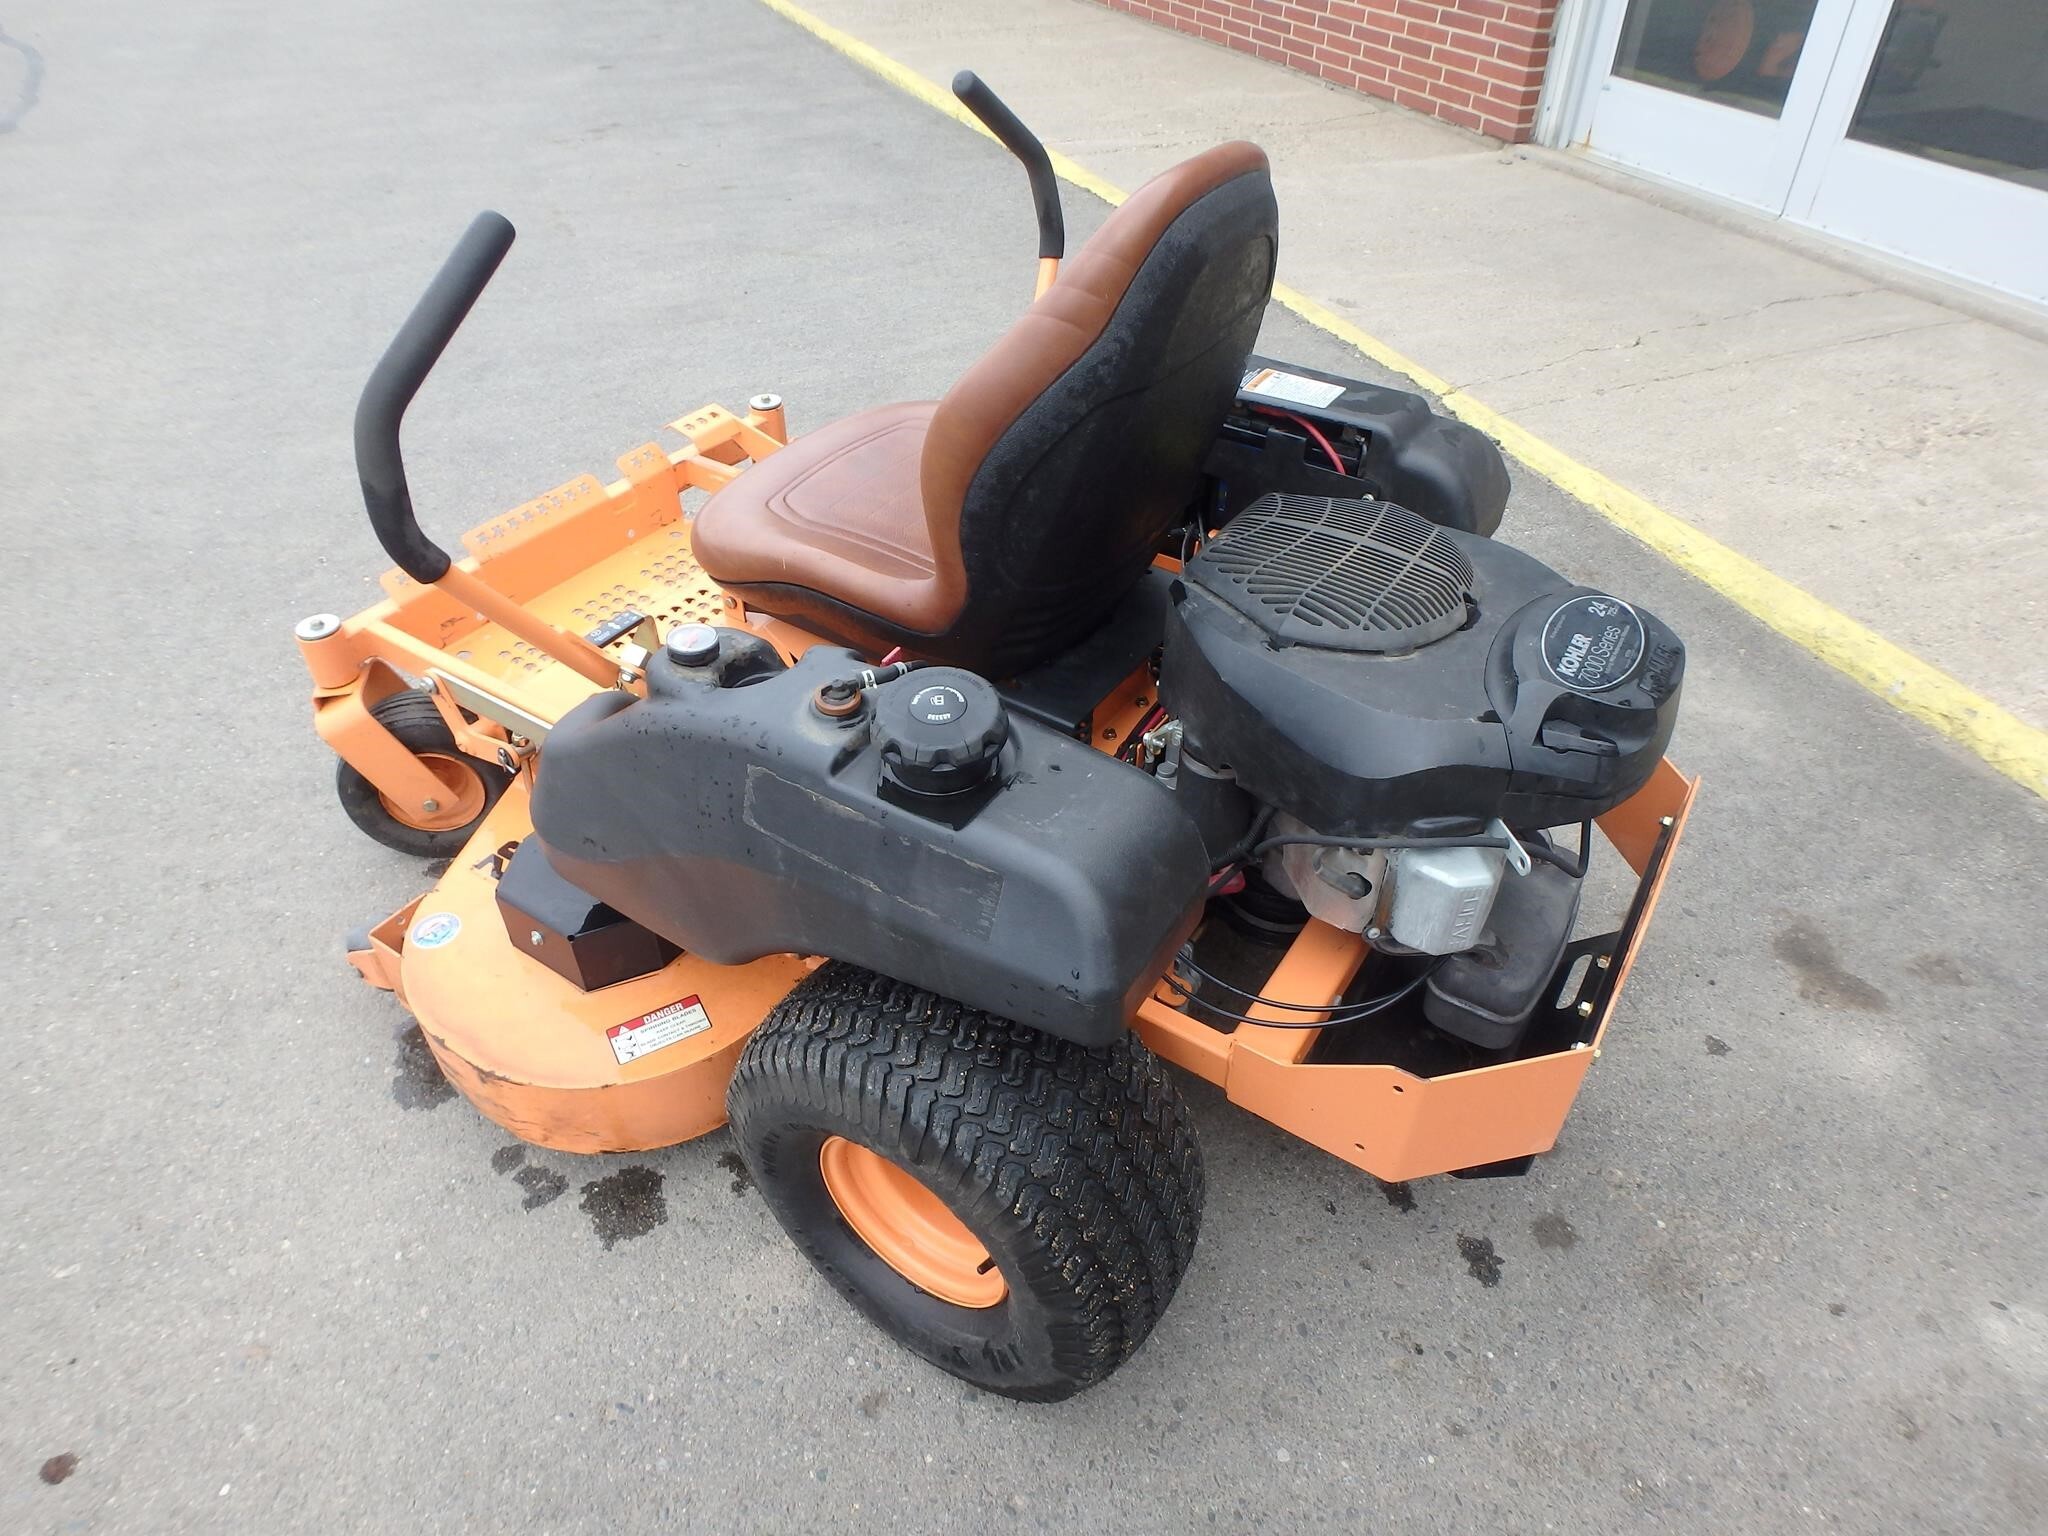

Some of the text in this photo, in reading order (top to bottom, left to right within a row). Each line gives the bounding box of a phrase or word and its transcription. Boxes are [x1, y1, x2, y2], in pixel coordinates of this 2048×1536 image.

[1587, 600, 1608, 617] 24
[1556, 633, 1593, 678] KOHLER
[1578, 656, 1606, 685] 7000
[1594, 625, 1621, 658] Series
[641, 1008, 697, 1034] SPINNING BLADES
[643, 1002, 684, 1024] DANGER
